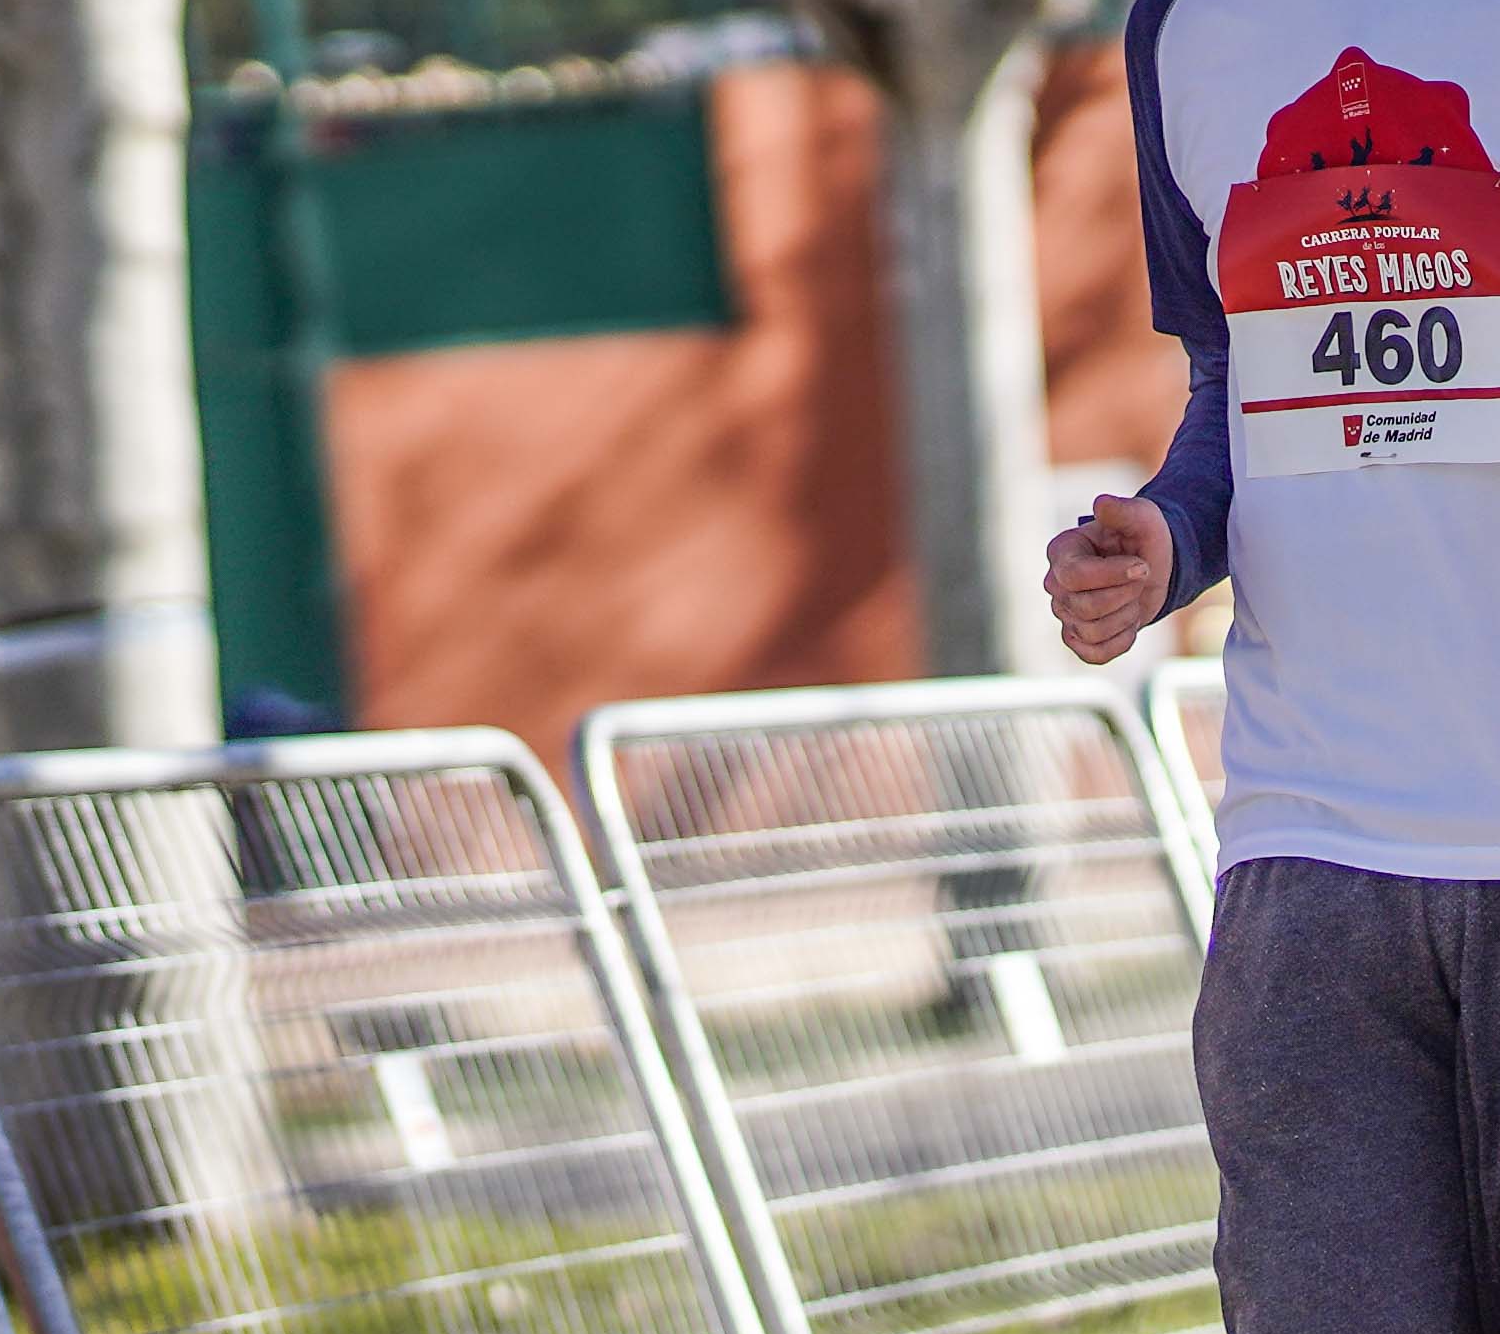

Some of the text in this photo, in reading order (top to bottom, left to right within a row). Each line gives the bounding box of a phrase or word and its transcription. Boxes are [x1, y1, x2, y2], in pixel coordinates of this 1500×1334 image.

[1301, 226, 1440, 248] CARRERA POPULAR
[1362, 241, 1372, 251] de
[1277, 249, 1472, 299] REYES MAGOS
[1312, 306, 1463, 386] 460
[1366, 411, 1437, 427] Comunidad
[1363, 427, 1433, 444] de Madrid
